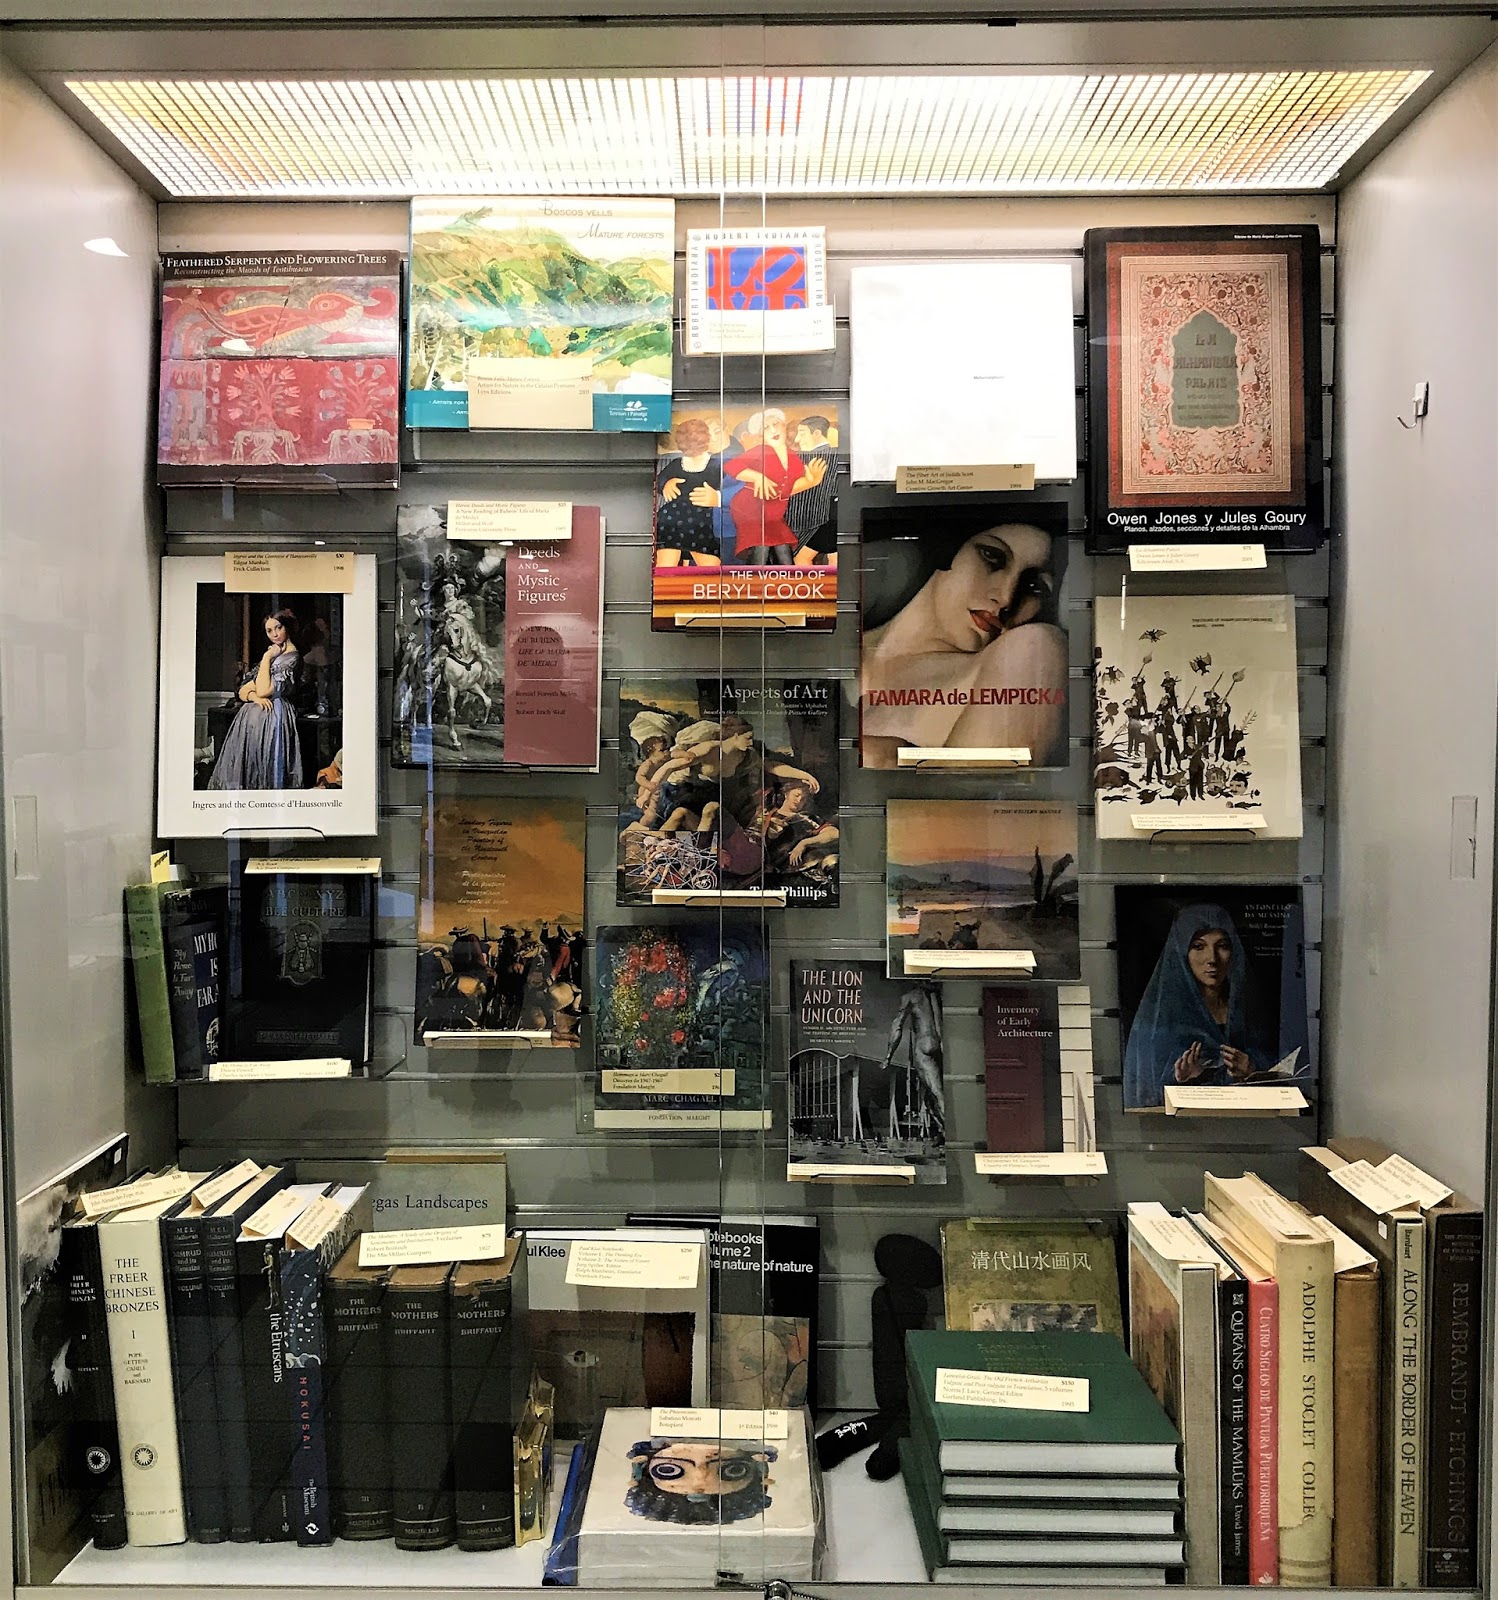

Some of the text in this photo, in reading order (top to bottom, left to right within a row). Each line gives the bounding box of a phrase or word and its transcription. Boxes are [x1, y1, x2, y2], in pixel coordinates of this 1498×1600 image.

[538, 200, 612, 217] BOSCOS VELLS
[577, 223, 623, 239] MATURE
[167, 253, 387, 268] FEATHERED SERPENTS AND FLOWERING TREES
[174, 267, 224, 276] Reconstructing
[226, 266, 236, 274] the
[262, 266, 270, 274] of
[1107, 510, 1306, 526] Owen Jones y Jules Goury
[518, 546, 560, 558] Deeds
[518, 575, 560, 590] Mystic
[730, 570, 825, 581] THE WORLD OF
[517, 590, 566, 604] Figures
[693, 583, 825, 600] BERYL COOK
[722, 685, 828, 702] Aspects of Art
[867, 688, 1065, 706] TAMARA de LEMPICKA
[192, 800, 343, 810] Ingres and the Comtesse d'Haussonville
[267, 889, 296, 899] ABC
[780, 886, 827, 900] Phillips
[265, 907, 344, 917] BEE CULTURE
[802, 970, 863, 986] THE LION
[197, 987, 213, 1009] FAR
[803, 990, 861, 1005] AND THE
[802, 1008, 863, 1024] UNICORN
[997, 1006, 1040, 1016] Inventory
[997, 1017, 1031, 1027] of Early
[643, 1095, 669, 1103] MARC
[405, 1195, 488, 1212] Landscapes
[539, 1246, 566, 1257] Klee
[743, 1246, 751, 1257] 2
[115, 1258, 139, 1269] THE
[722, 1259, 813, 1273] nature of nature
[971, 1250, 1092, 1271] 清代山水画风
[110, 1272, 148, 1284] FREER
[105, 1287, 156, 1298] CHINESE
[106, 1301, 159, 1313] BRONZES
[334, 1306, 381, 1316] MOTHERS
[457, 1310, 506, 1319] MOTHERS
[391, 1311, 439, 1320] MOTHERS
[1302, 1282, 1316, 1364] ADOLPHE
[338, 1323, 379, 1331] BRIFFAULT
[461, 1327, 502, 1335] BRIFFAULT
[270, 1313, 285, 1383] the Etruscans
[1450, 1282, 1470, 1414] REMBRANDT
[1232, 1374, 1244, 1392] OF
[1232, 1397, 1244, 1422] THE
[1400, 1269, 1418, 1535] ALONG THE BORDER OF HEAVEN
[300, 1376, 311, 1450] HOKUSAI
[1302, 1374, 1316, 1450] STOCLET
[1258, 1307, 1273, 1542] CUATRO SIGLOS DE PINTURA PUERTORRIQUEÑA
[1448, 1432, 1466, 1542] ETCHINGS
[303, 1487, 311, 1516] Museum
[309, 1486, 317, 1508] British
[1234, 1504, 1243, 1556] David James
